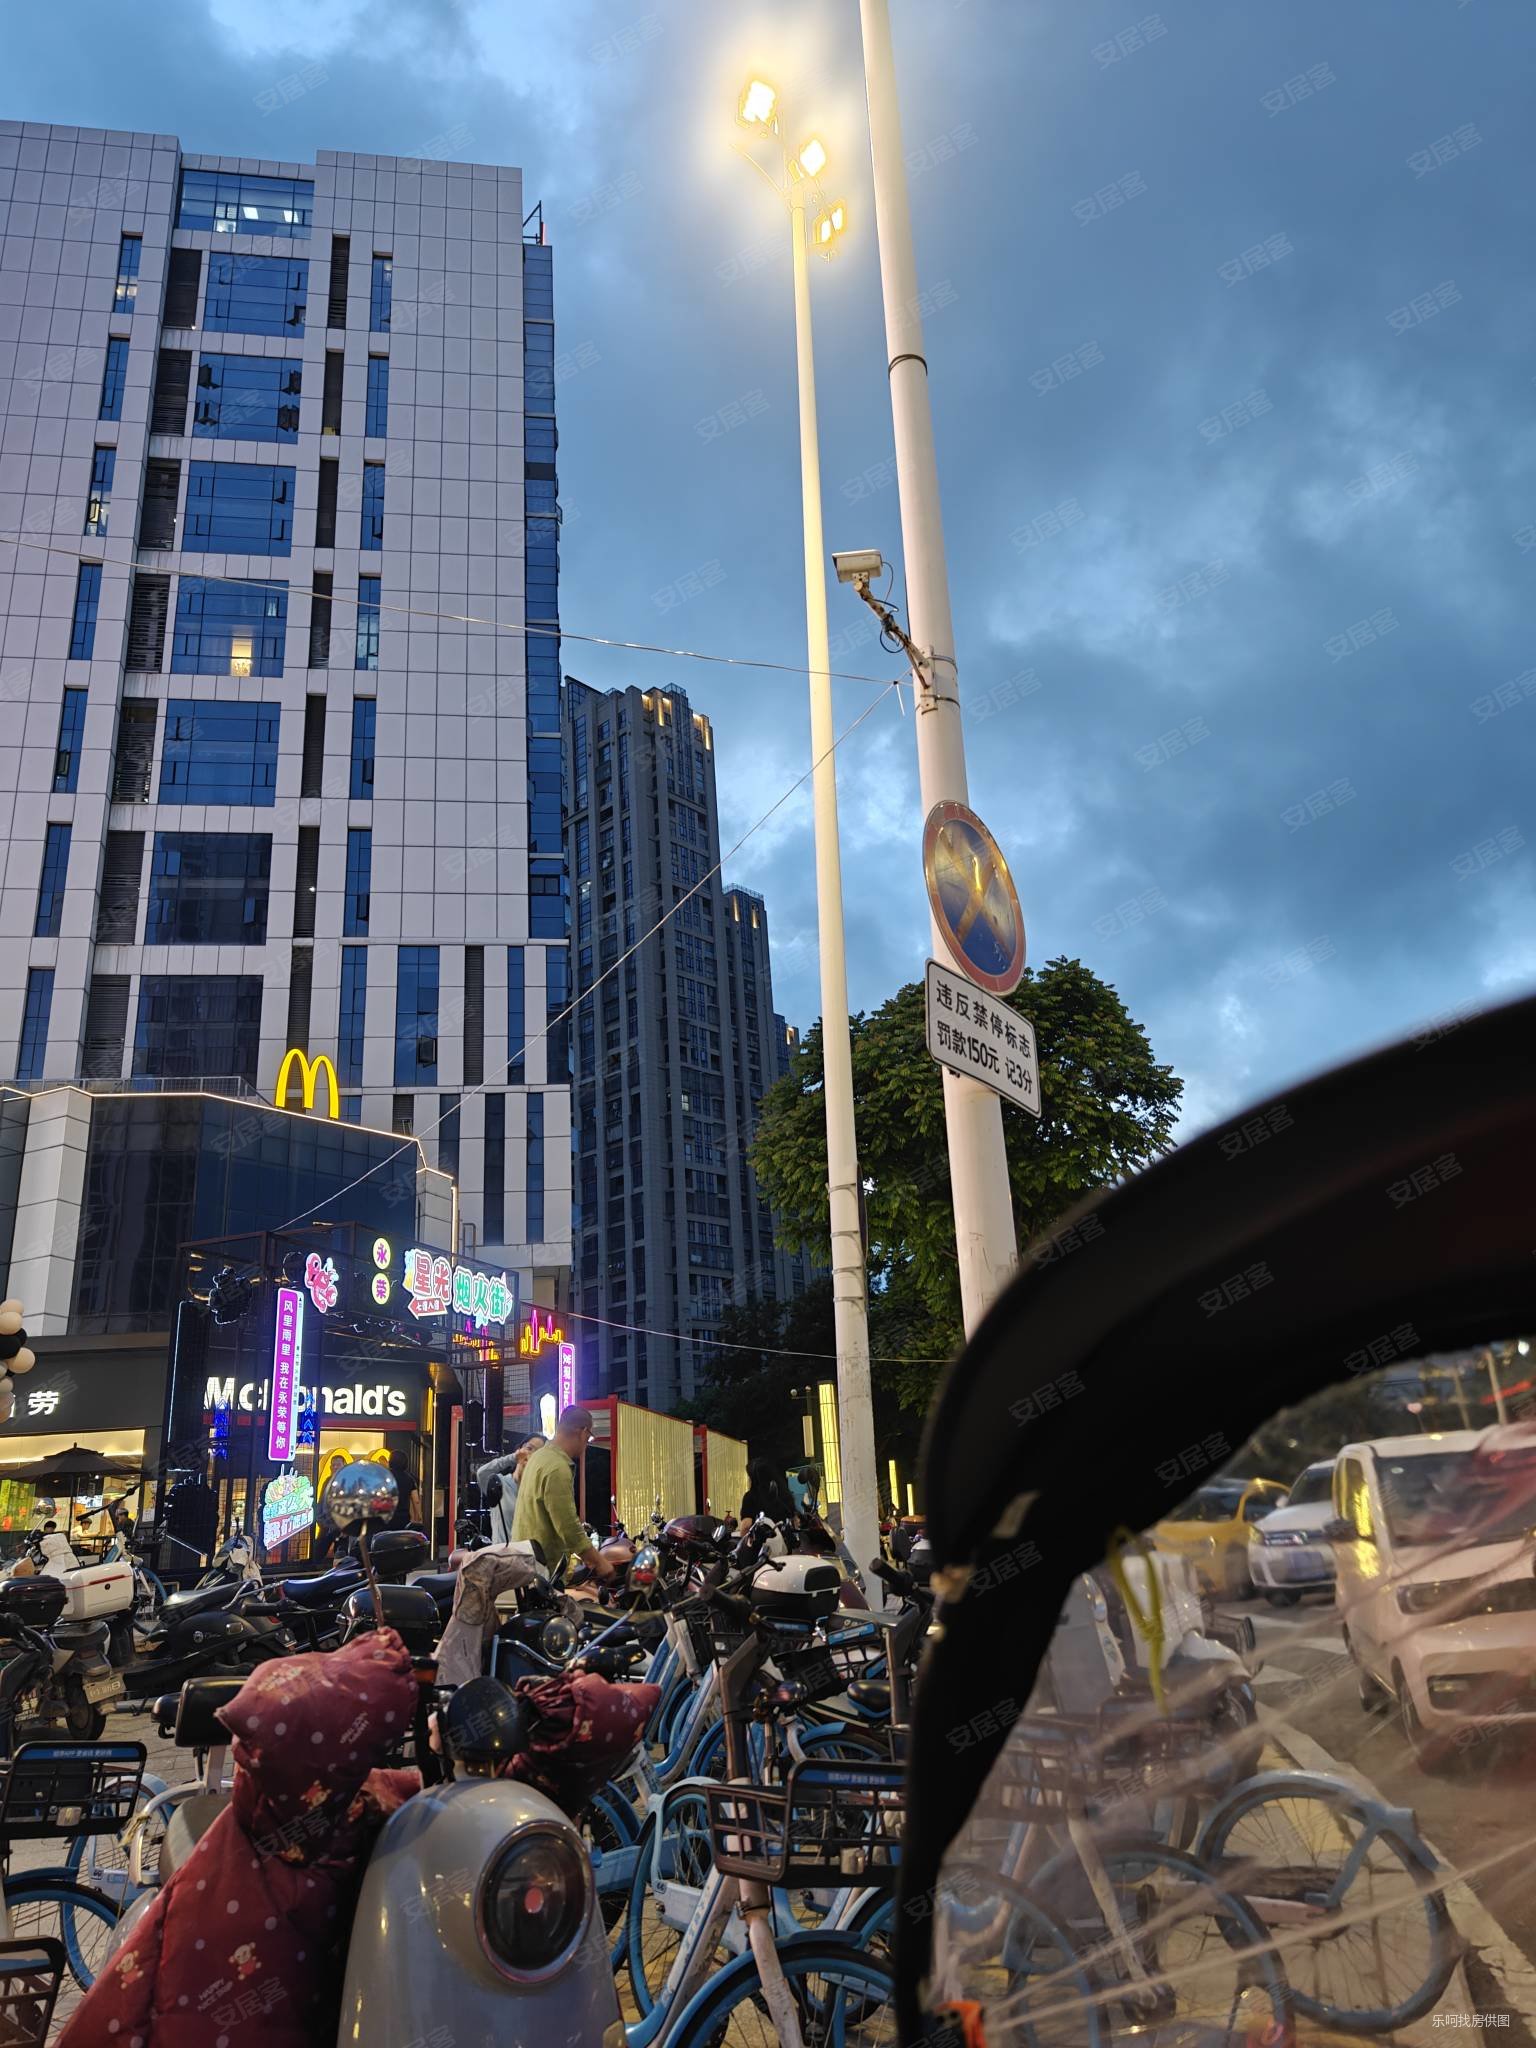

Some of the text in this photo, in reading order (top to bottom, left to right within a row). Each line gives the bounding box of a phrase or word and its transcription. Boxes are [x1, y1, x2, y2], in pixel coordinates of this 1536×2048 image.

[936, 979, 1031, 1058] 违反禁停标志
[937, 1020, 1033, 1094] 罚款150元 记3分
[376, 1243, 388, 1299] 永荣
[415, 1255, 505, 1317] 星光烟火街
[275, 1300, 293, 1449] 风里雨里 我在永荣等你
